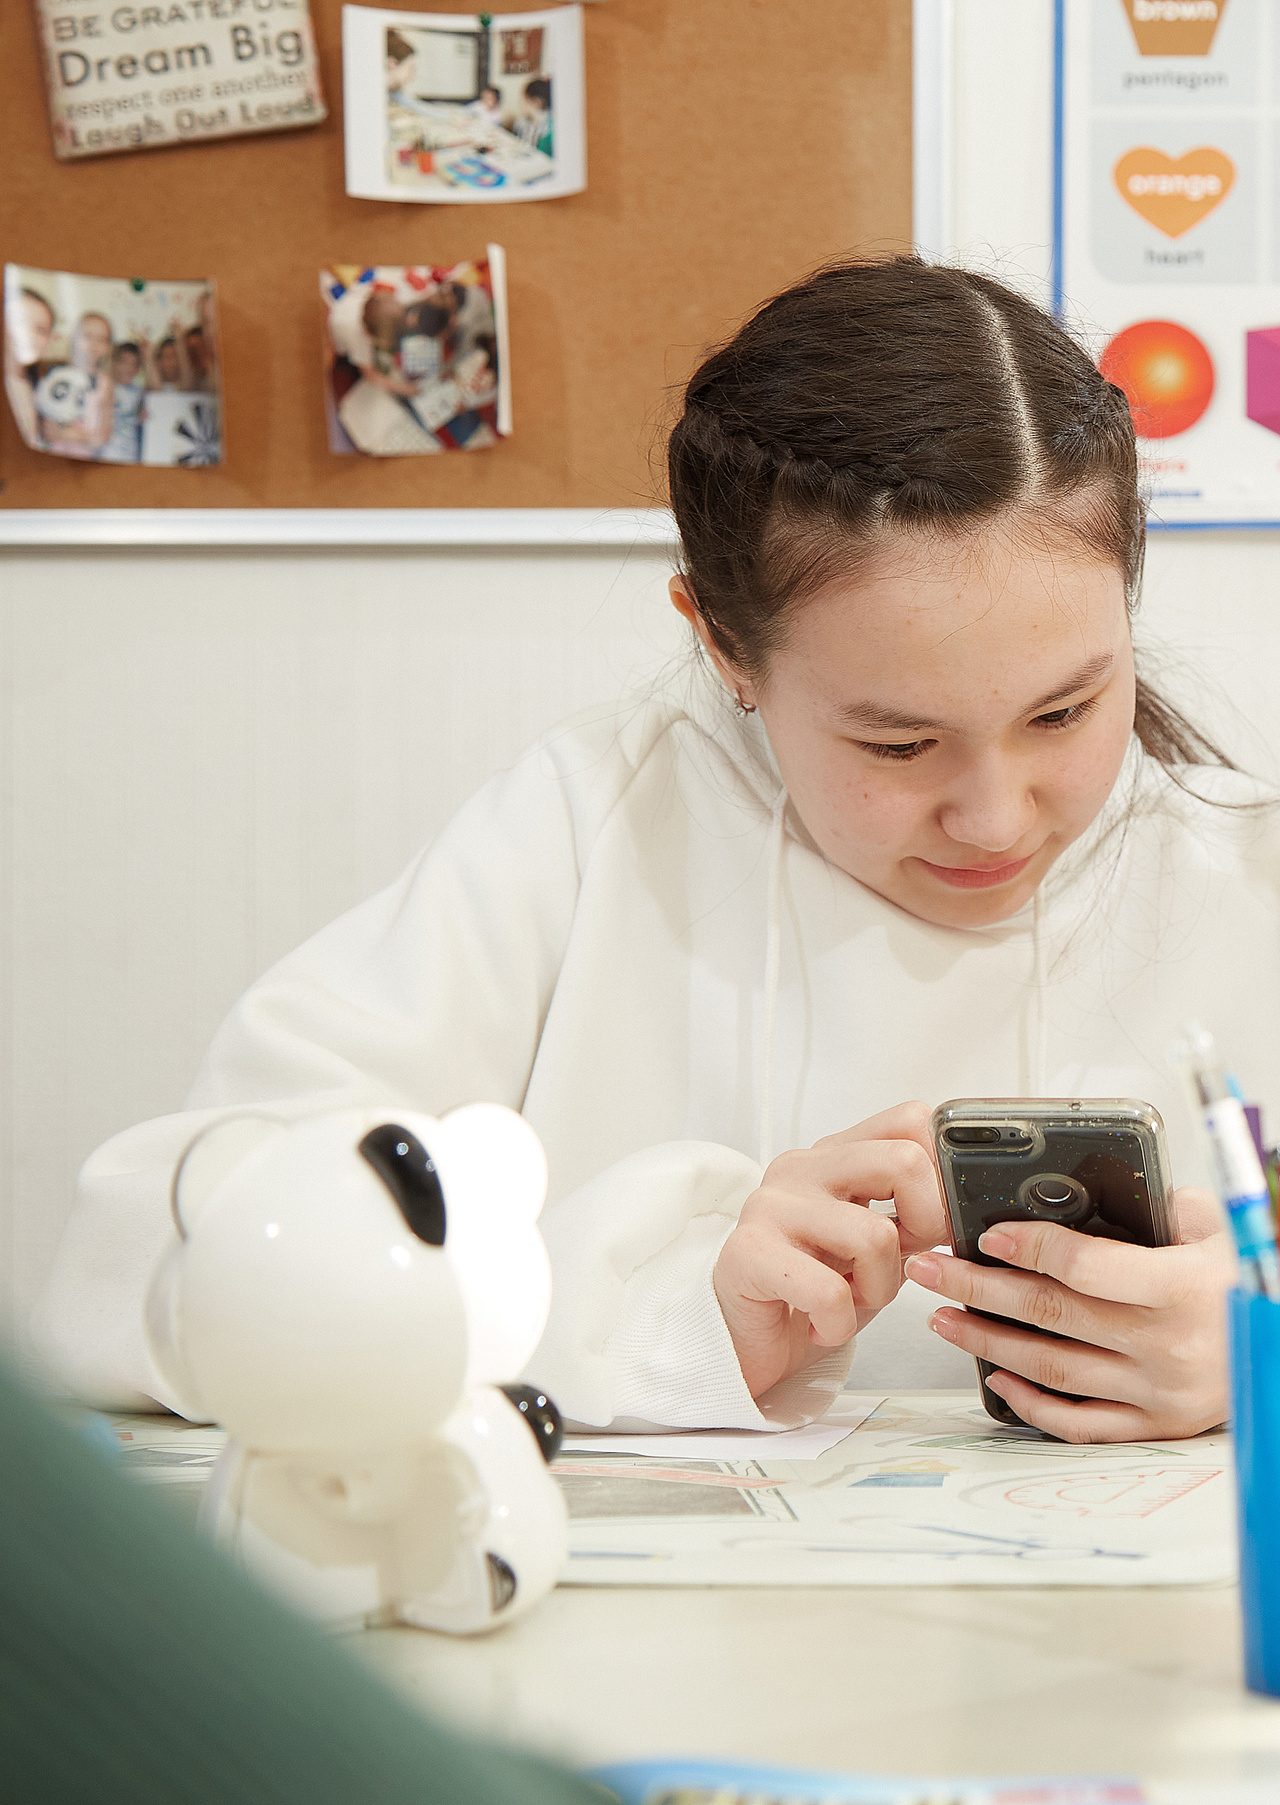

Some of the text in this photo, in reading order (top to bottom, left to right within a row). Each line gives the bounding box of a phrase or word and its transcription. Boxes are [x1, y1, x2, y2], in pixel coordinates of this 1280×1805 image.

[52, 15, 103, 42] BE
[58, 22, 304, 87] Dream Big
[159, 84, 203, 105] one
[1121, 71, 1229, 92] pentagon
[69, 92, 316, 149] Laugh Out Loud
[1126, 174, 1223, 200] orange
[1143, 249, 1205, 267] heart
